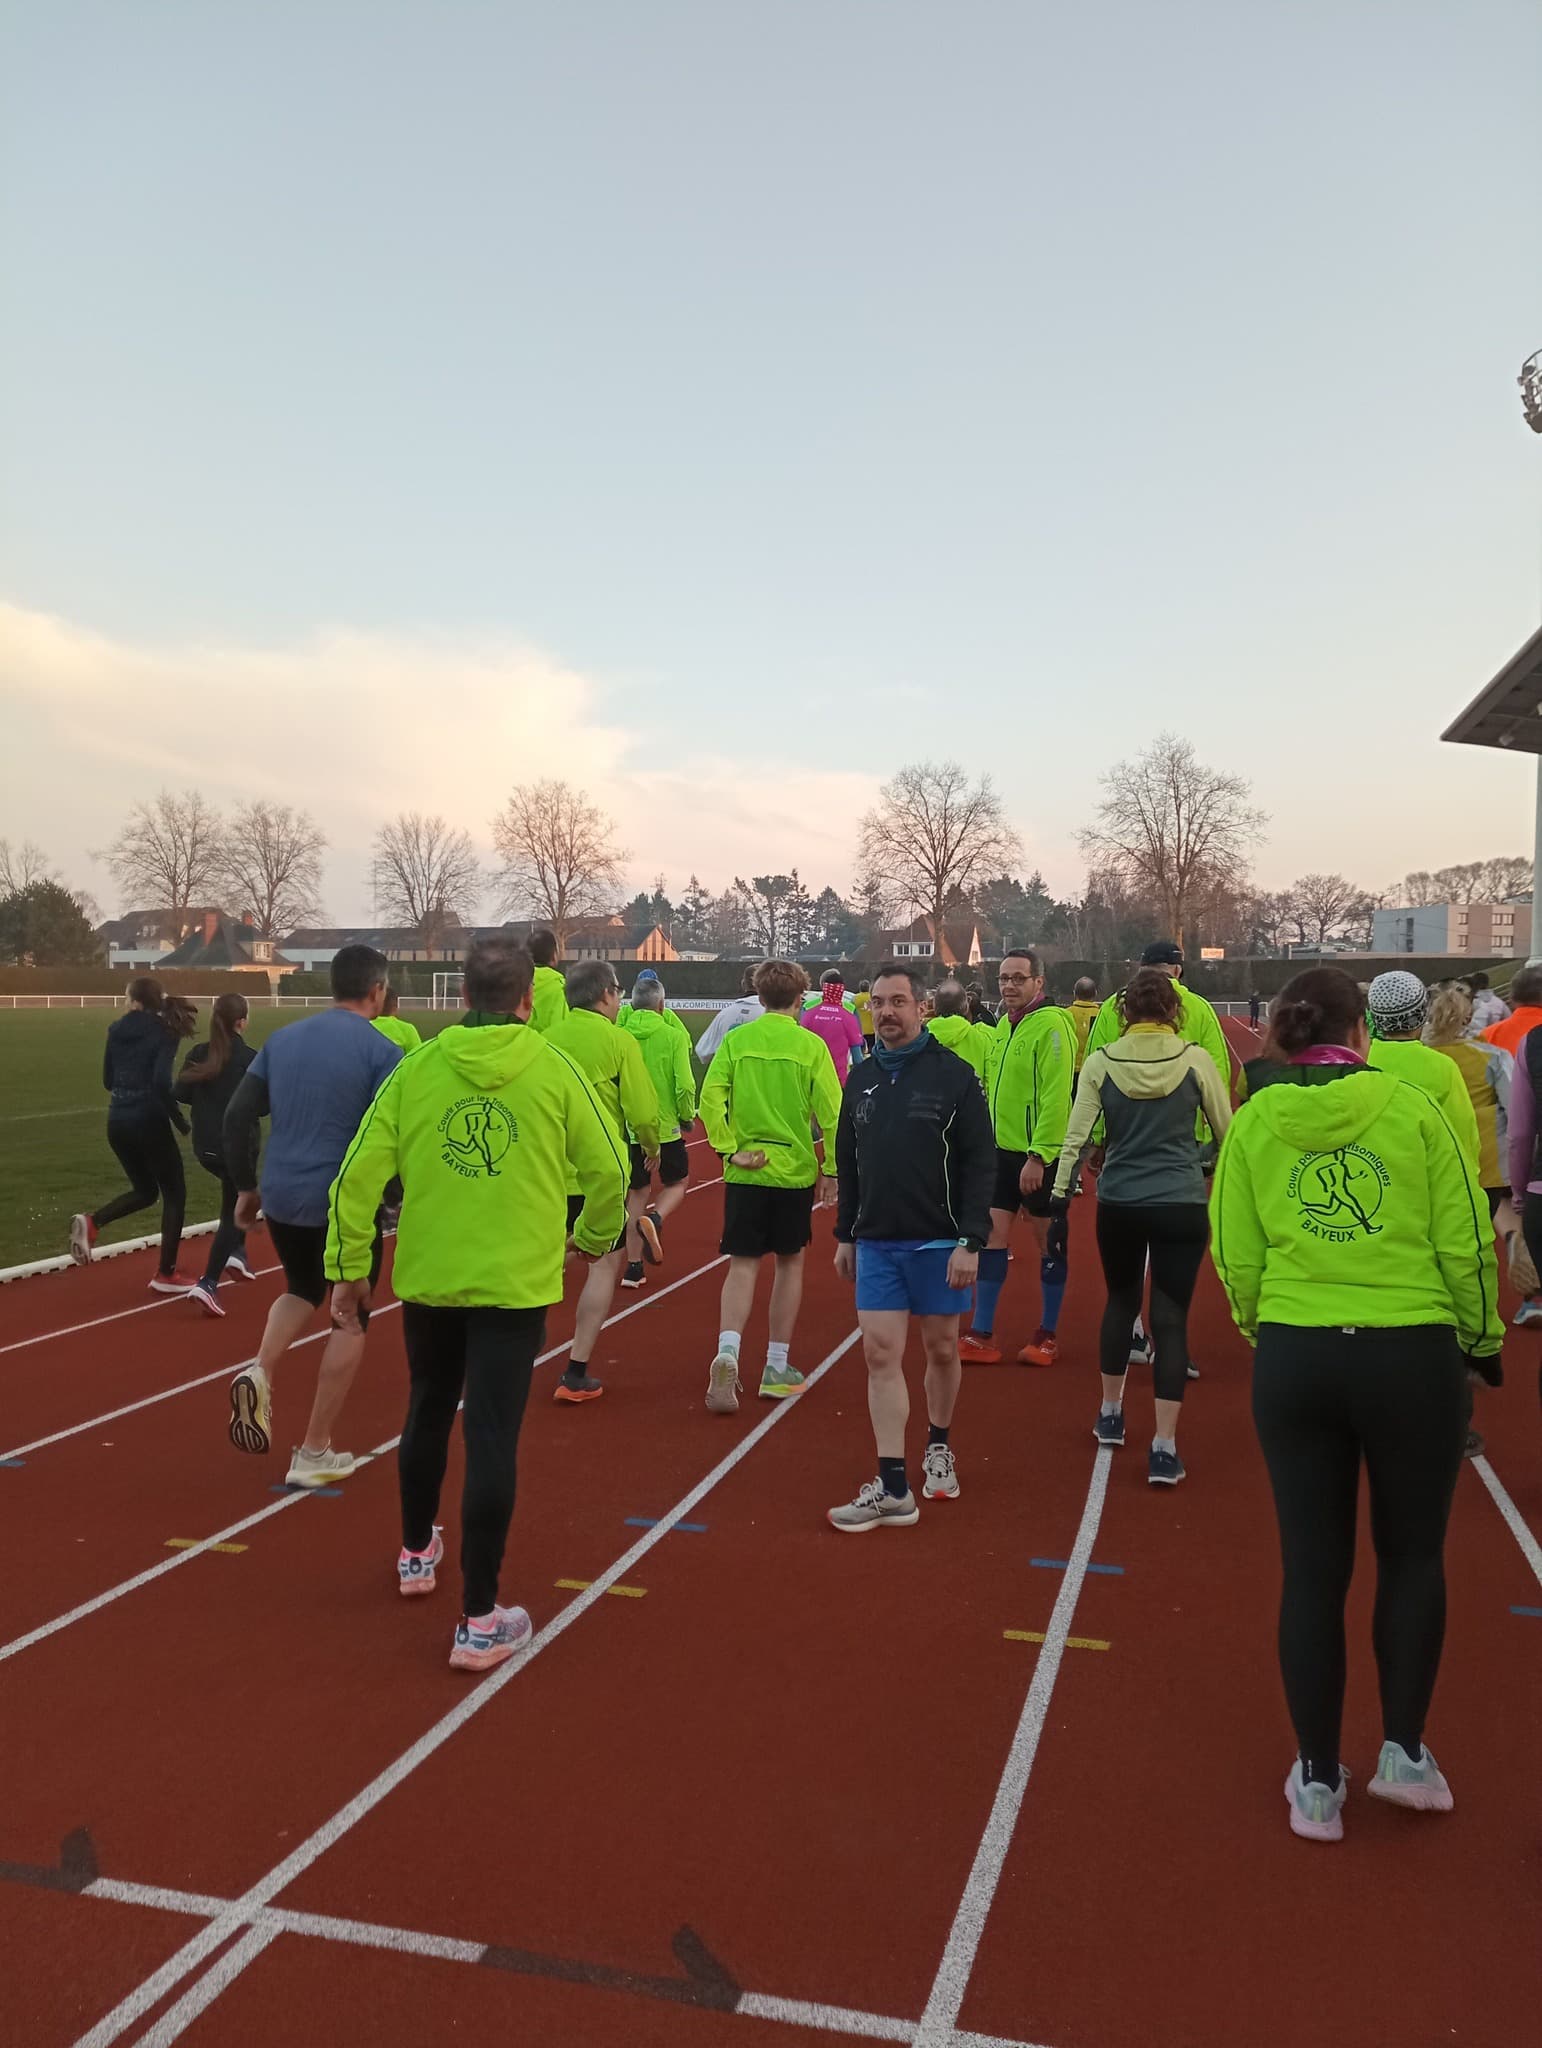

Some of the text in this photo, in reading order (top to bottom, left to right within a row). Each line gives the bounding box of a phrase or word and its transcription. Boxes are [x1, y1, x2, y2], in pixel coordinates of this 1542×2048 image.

[455, 1096, 474, 1109] pour
[441, 1152, 480, 1178] BAYEUX
[1286, 1166, 1301, 1198] Courir
[1301, 1219, 1356, 1242] BAYEUX
